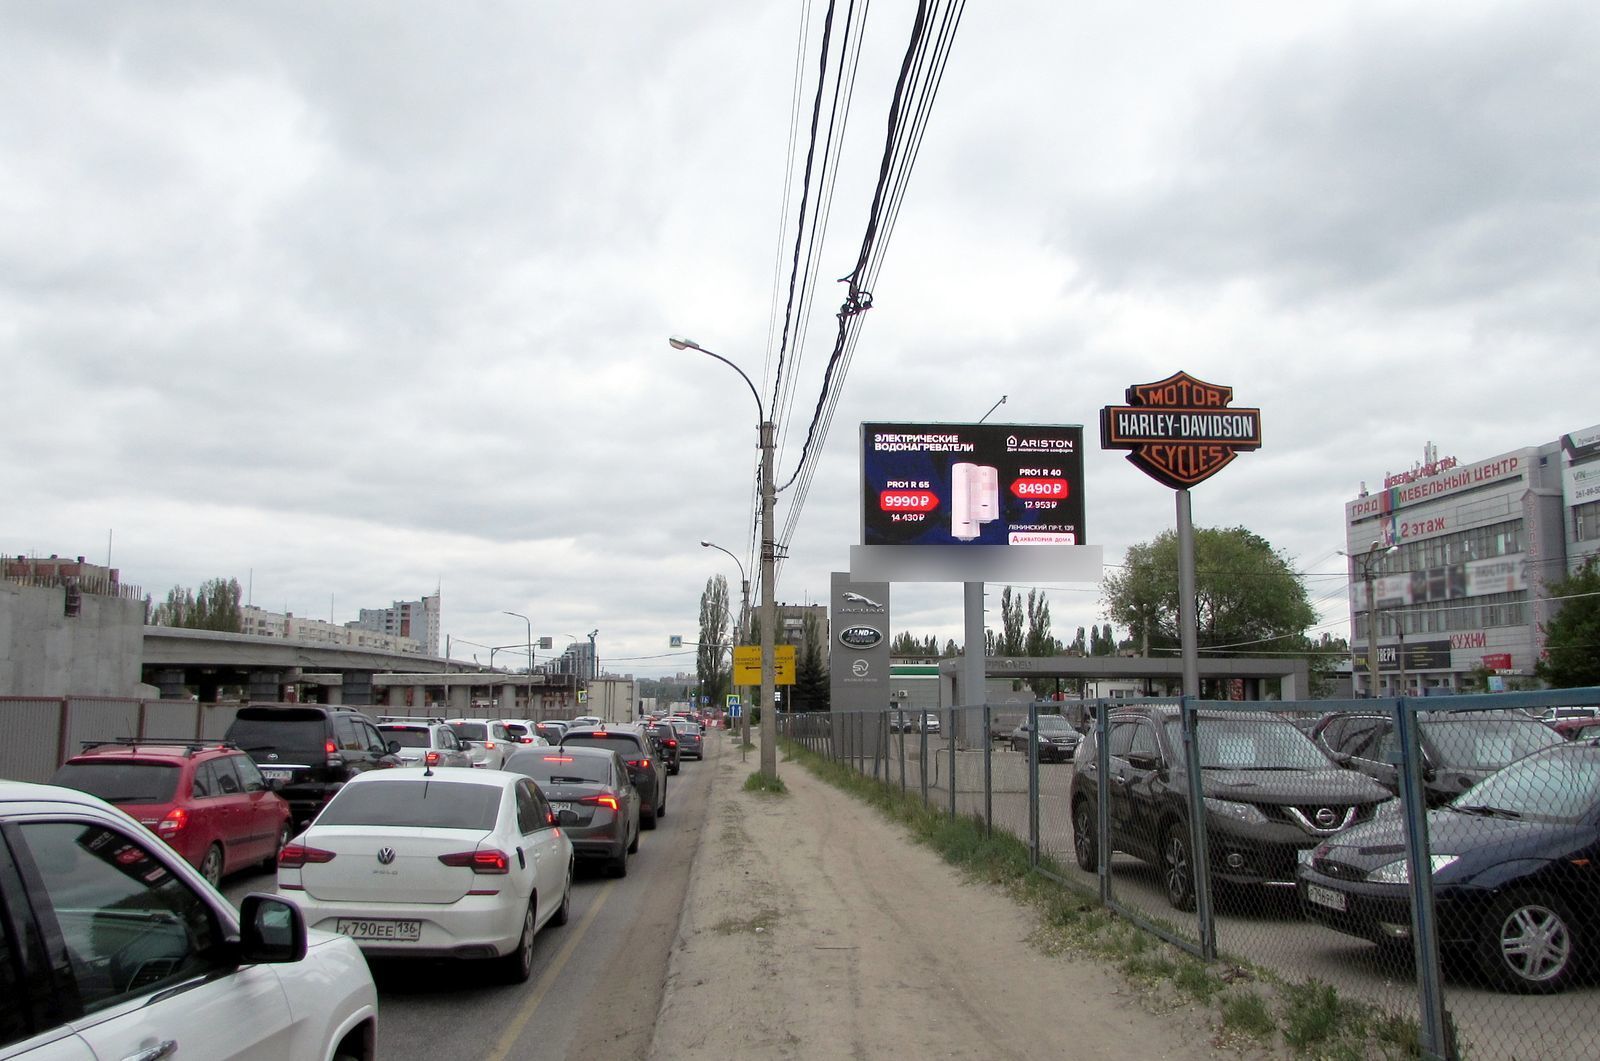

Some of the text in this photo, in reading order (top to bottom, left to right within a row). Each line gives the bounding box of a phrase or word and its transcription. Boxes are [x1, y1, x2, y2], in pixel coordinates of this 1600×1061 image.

[1150, 380, 1220, 406] MOTOR
[1119, 414, 1253, 437] HARLEY-DAVIDSON
[874, 434, 959, 443] ЭЛЕКТРИЧЕСКИЕ
[1020, 439, 1073, 448] ARISTON
[874, 443, 974, 452] ВОДОНАГРЕВАТЕЛИ
[1152, 446, 1222, 477] CYCLES
[1351, 457, 1518, 517] ГРАД МЕБЕЛЬНЫЙ ЦЕНТР
[1401, 523, 1409, 537] 2
[1450, 632, 1487, 649] КУХНИ
[398, 921, 416, 934] 136
